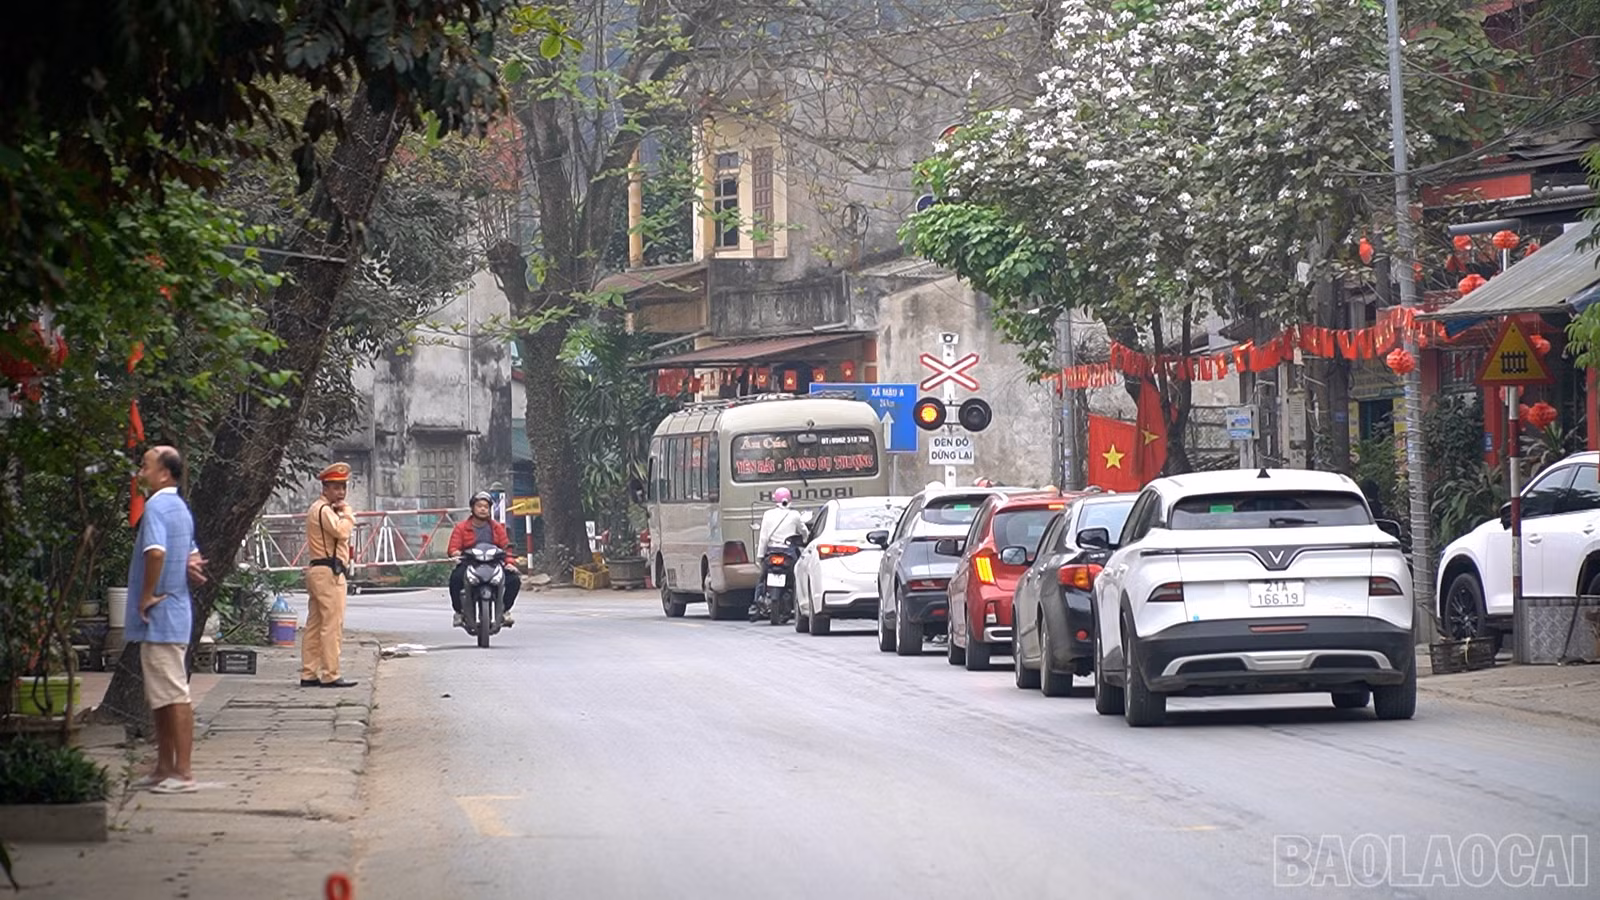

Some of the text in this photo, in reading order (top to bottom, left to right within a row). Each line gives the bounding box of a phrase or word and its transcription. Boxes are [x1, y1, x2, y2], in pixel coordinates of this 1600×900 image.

[899, 388, 904, 397] A
[760, 486, 854, 501] HUNDAI
[1265, 580, 1288, 592] 21A
[1258, 593, 1299, 605] 166.19
